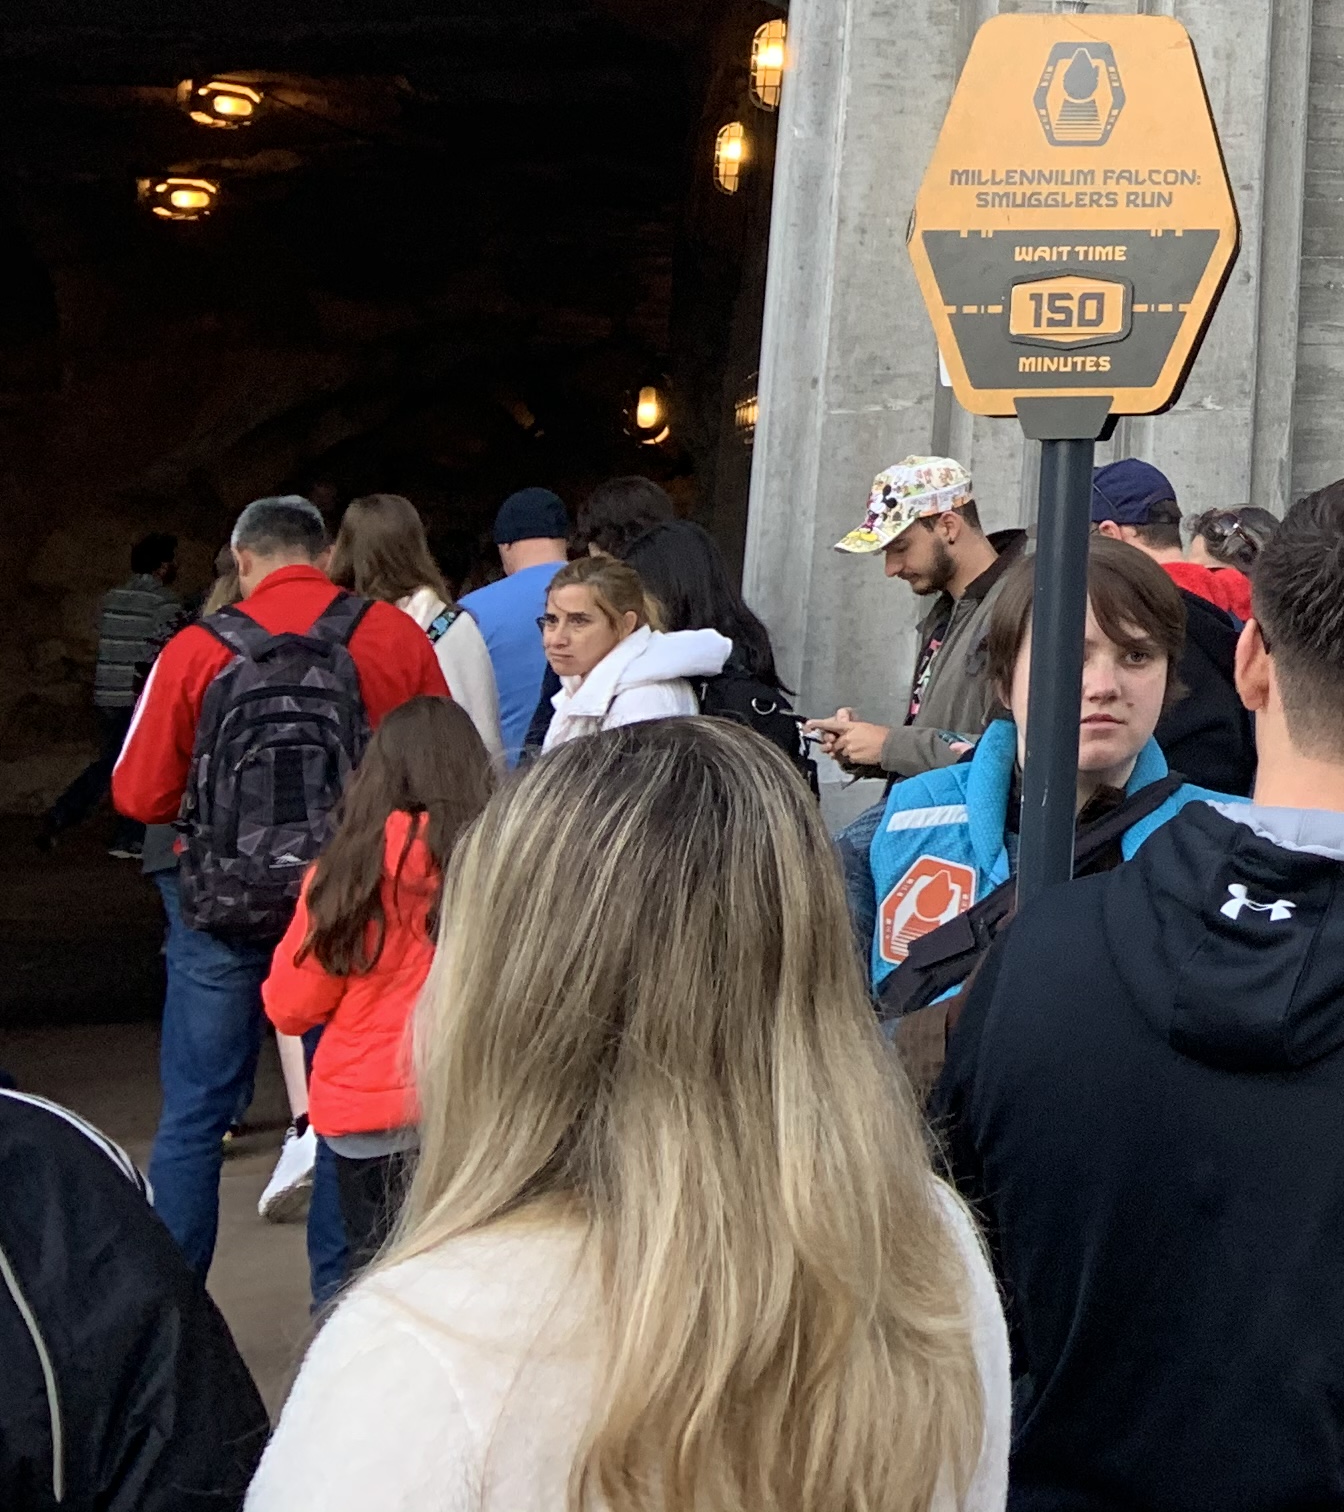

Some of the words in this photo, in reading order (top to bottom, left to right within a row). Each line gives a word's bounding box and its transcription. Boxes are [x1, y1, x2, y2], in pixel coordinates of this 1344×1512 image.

[949, 169, 1096, 186] MILLENNIUM
[1102, 169, 1201, 186] FALCON:
[975, 191, 1119, 208] SMUGGLERS
[1125, 191, 1173, 208] RUN
[1014, 246, 1071, 261] WAIT
[1074, 245, 1127, 261] TIME
[1029, 292, 1105, 328] 150
[1018, 356, 1111, 372] MINUTES
